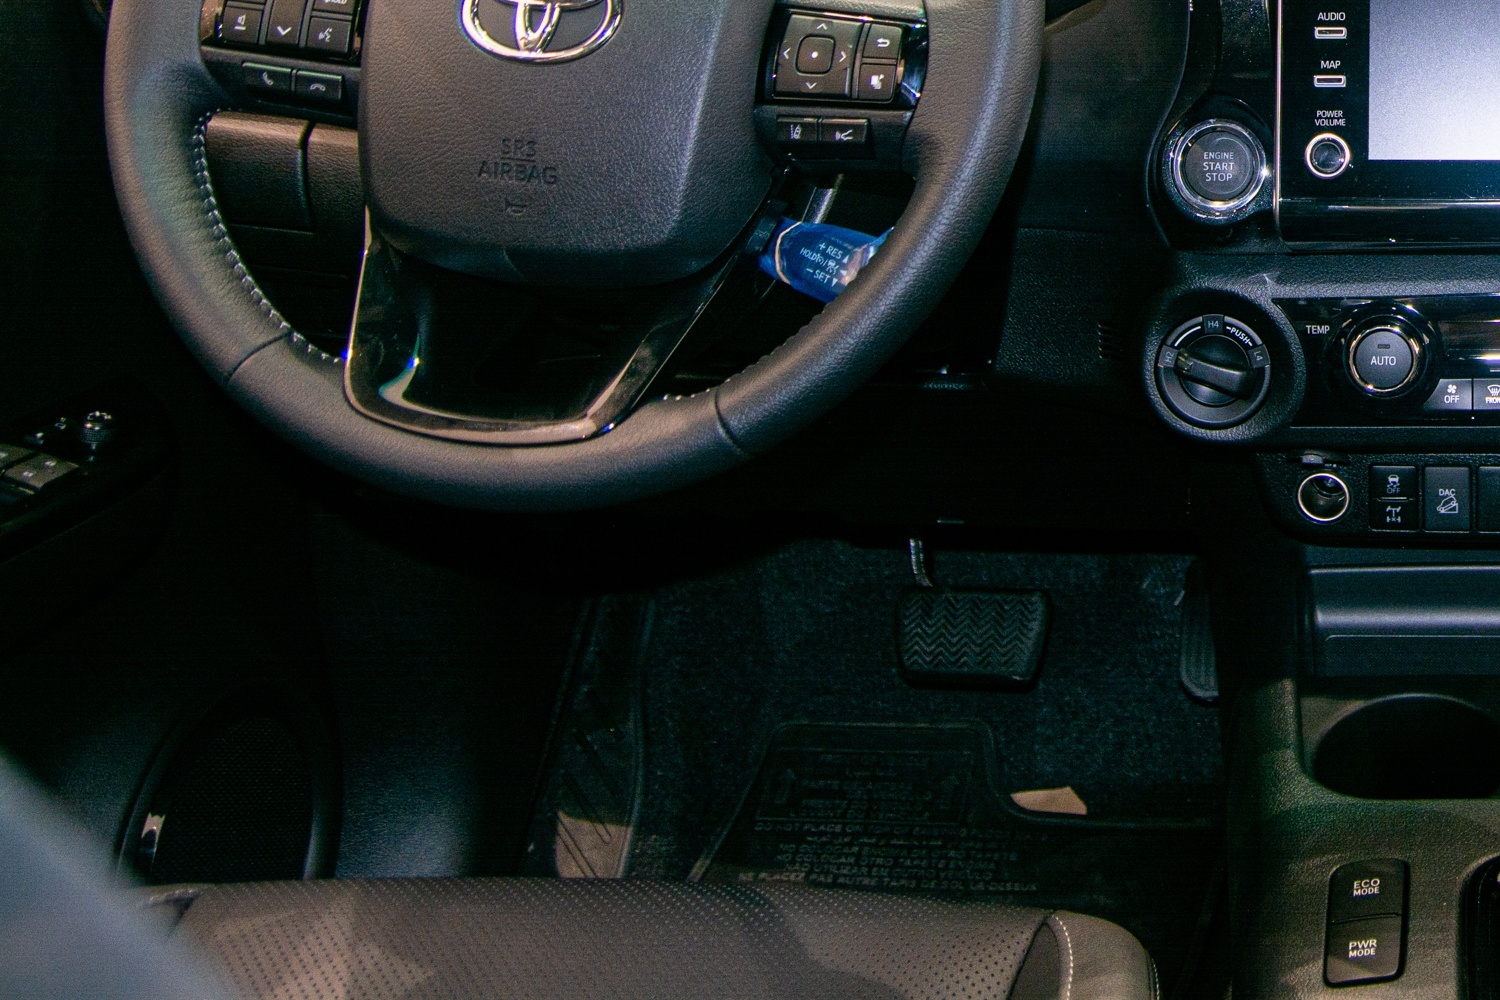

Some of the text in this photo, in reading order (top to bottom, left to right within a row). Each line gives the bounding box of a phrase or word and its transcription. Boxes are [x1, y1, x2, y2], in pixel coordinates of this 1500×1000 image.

[1317, 12, 1346, 21] AUDIO
[1320, 60, 1341, 69] MAP
[1316, 110, 1343, 118] POWER
[1315, 118, 1346, 126] VOLUME
[501, 138, 537, 157] SRS
[1203, 151, 1234, 160] ENGINE
[1203, 162, 1235, 171] START
[478, 160, 558, 185] AIRBAG
[1205, 172, 1233, 182] STOP
[800, 247, 817, 260] HOLD
[826, 245, 843, 260] RES
[813, 271, 831, 284] SET
[1207, 320, 1219, 329] H4
[1305, 325, 1331, 335] TEMP
[1230, 326, 1251, 345] PUSH
[1164, 351, 1175, 364] H2
[1252, 349, 1264, 362] L4
[1370, 356, 1397, 367] AUTO
[1444, 394, 1460, 404] OFF
[1438, 488, 1456, 497] DAC
[1353, 878, 1380, 890] ECO
[1353, 886, 1380, 897] MODE
[1348, 938, 1378, 951] PWR
[1348, 947, 1376, 959] MODE
